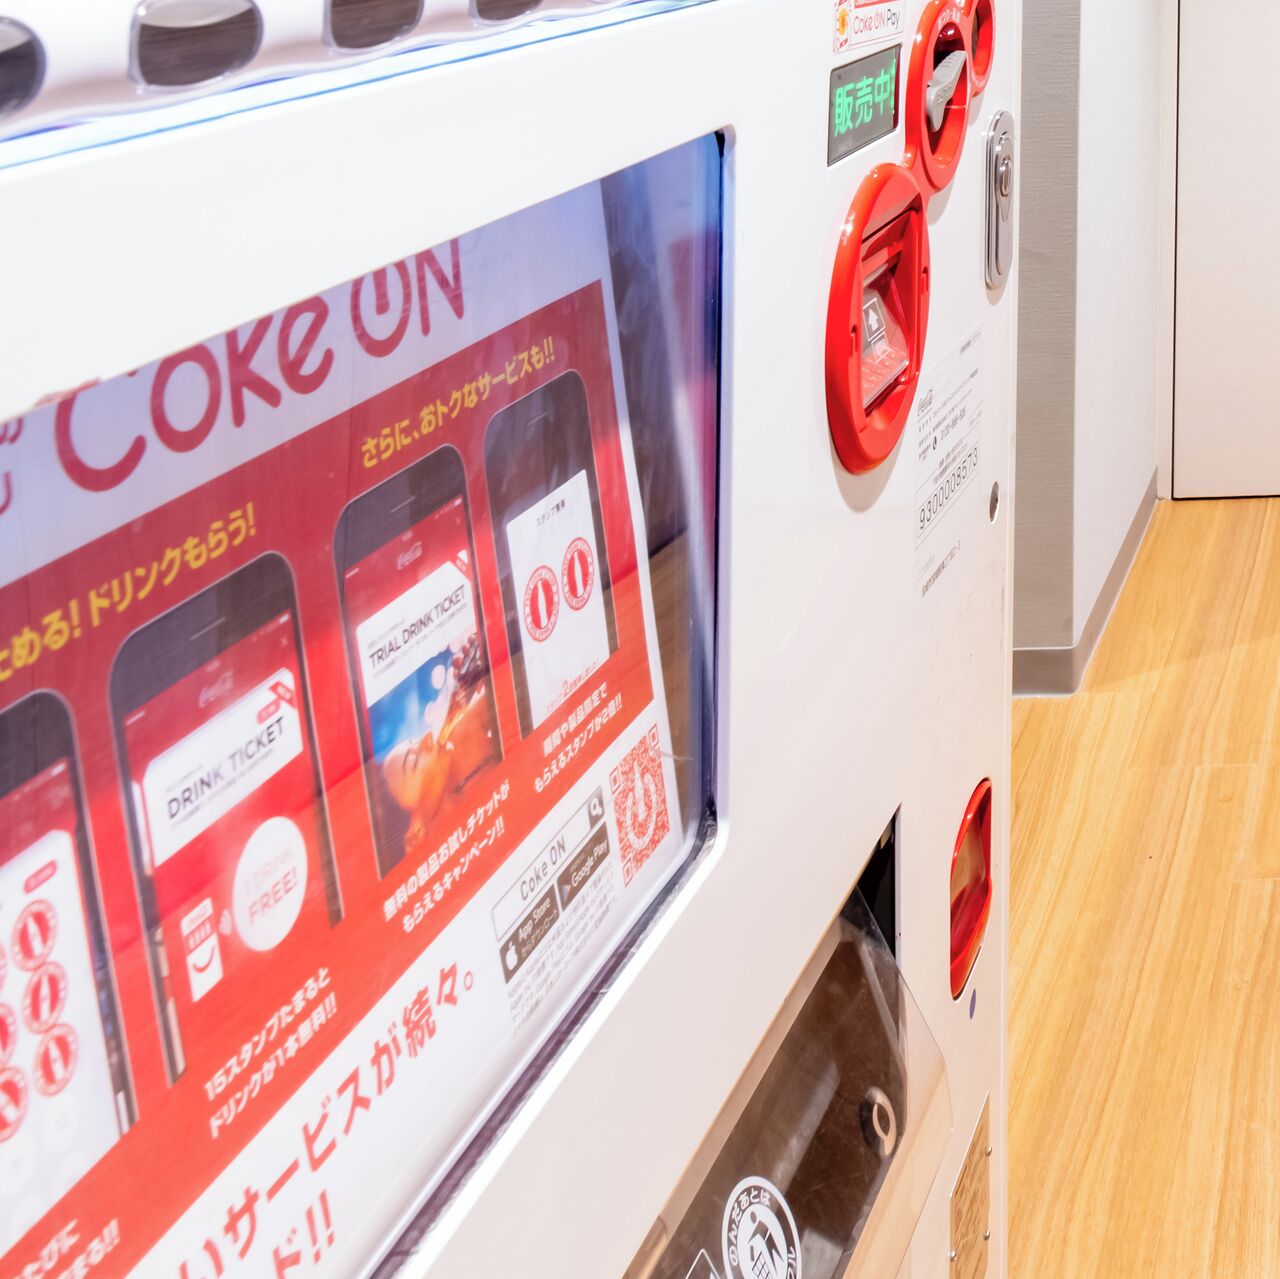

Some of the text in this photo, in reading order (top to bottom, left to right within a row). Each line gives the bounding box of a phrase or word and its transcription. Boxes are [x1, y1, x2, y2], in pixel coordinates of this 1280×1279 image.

[853, 11, 873, 36] Coke
[887, 7, 901, 32] Pay
[834, 70, 891, 138] 販売中
[368, 584, 466, 670] TRIAL DRINK TICKET
[166, 716, 285, 820] DRINK TICKET
[519, 834, 567, 902] Coke ON
[570, 857, 595, 888] Google
